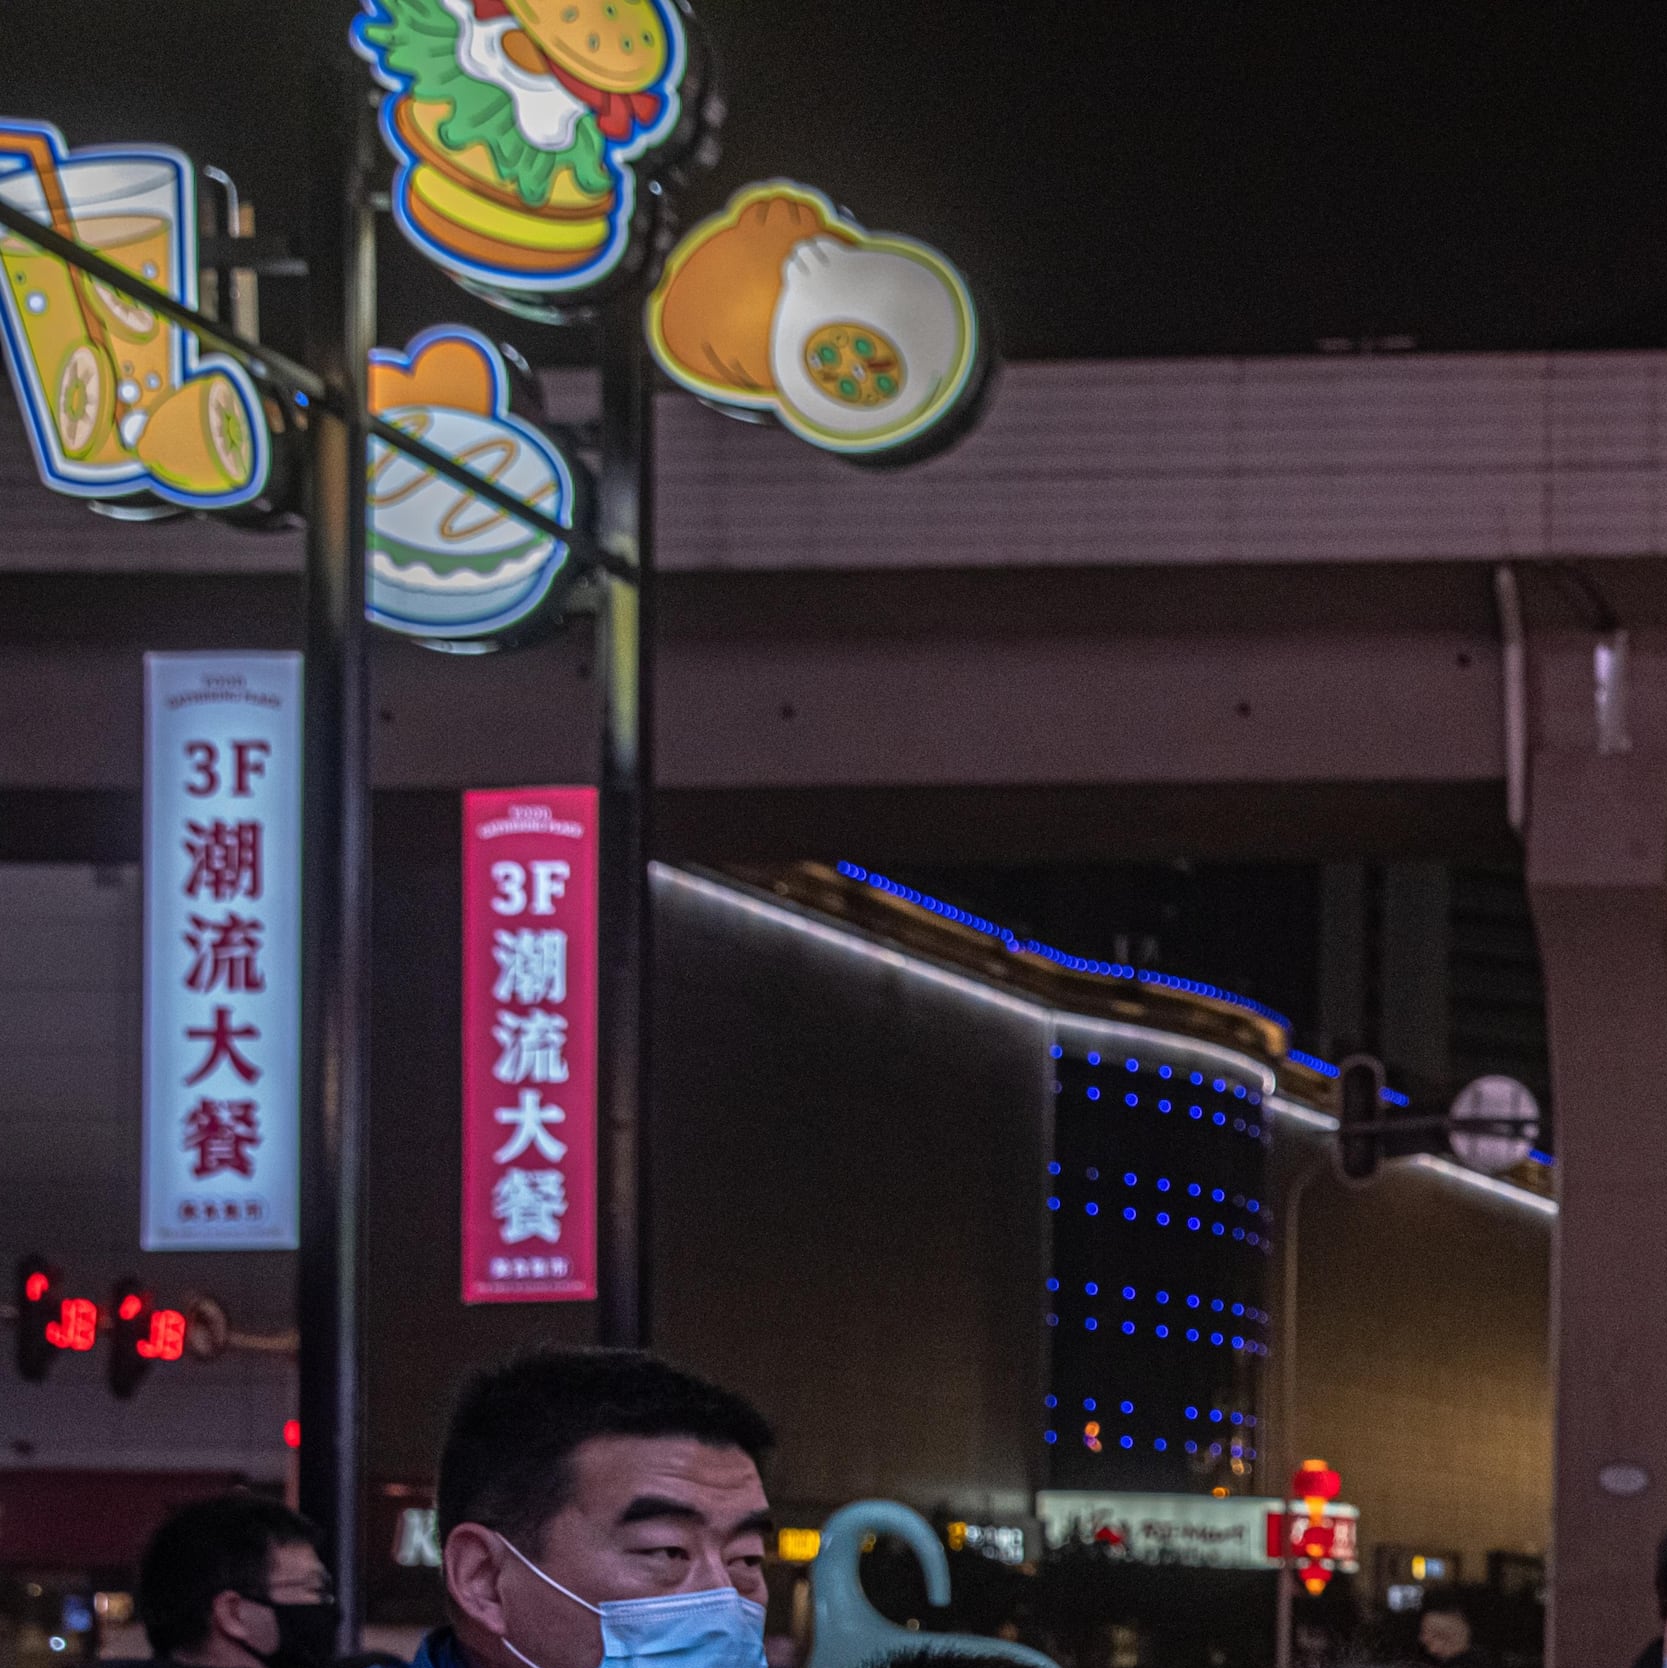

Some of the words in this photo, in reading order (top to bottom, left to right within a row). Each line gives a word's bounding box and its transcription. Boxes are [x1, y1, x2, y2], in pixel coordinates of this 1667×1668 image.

[182, 820, 266, 1182] 潮流大餐
[490, 861, 570, 916] 3F
[492, 930, 569, 1244] 潮流大餐
